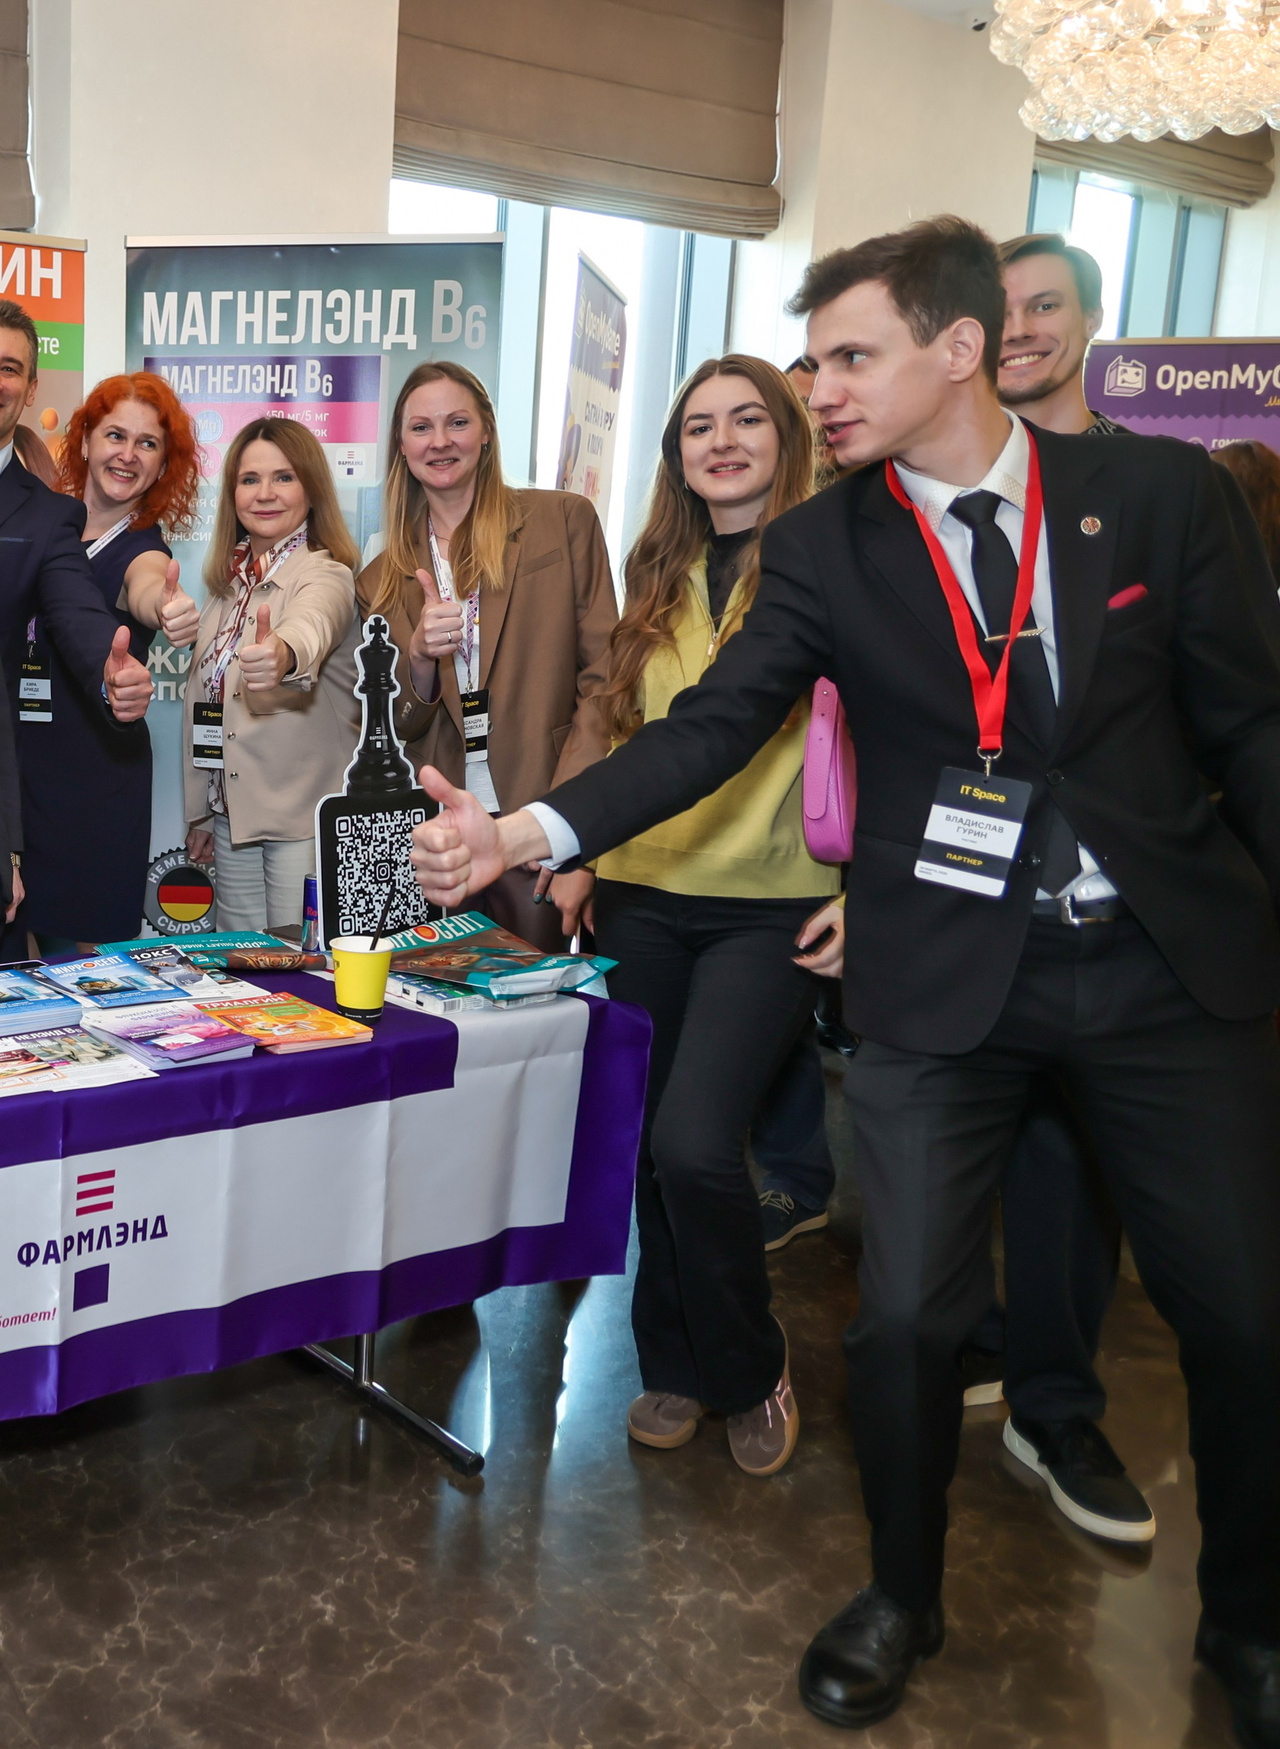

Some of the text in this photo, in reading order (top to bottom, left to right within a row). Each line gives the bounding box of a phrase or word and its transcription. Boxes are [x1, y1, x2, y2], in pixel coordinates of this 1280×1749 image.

[142, 289, 417, 350] МАГНЕЛЭНД
[315, 412, 329, 422] мг
[960, 785, 1006, 803] IT Space
[945, 814, 1004, 833] ВЛАДИСЛАВ
[957, 826, 987, 839] ГУРИН
[946, 853, 983, 866] ПАРТНЕР
[157, 915, 211, 935] СЫРЬЕ
[391, 913, 486, 948] ИРРОСЕПТ
[200, 995, 285, 1009] ТРИАЛГИН
[17, 1215, 168, 1267] ФАРМЛЭНД
